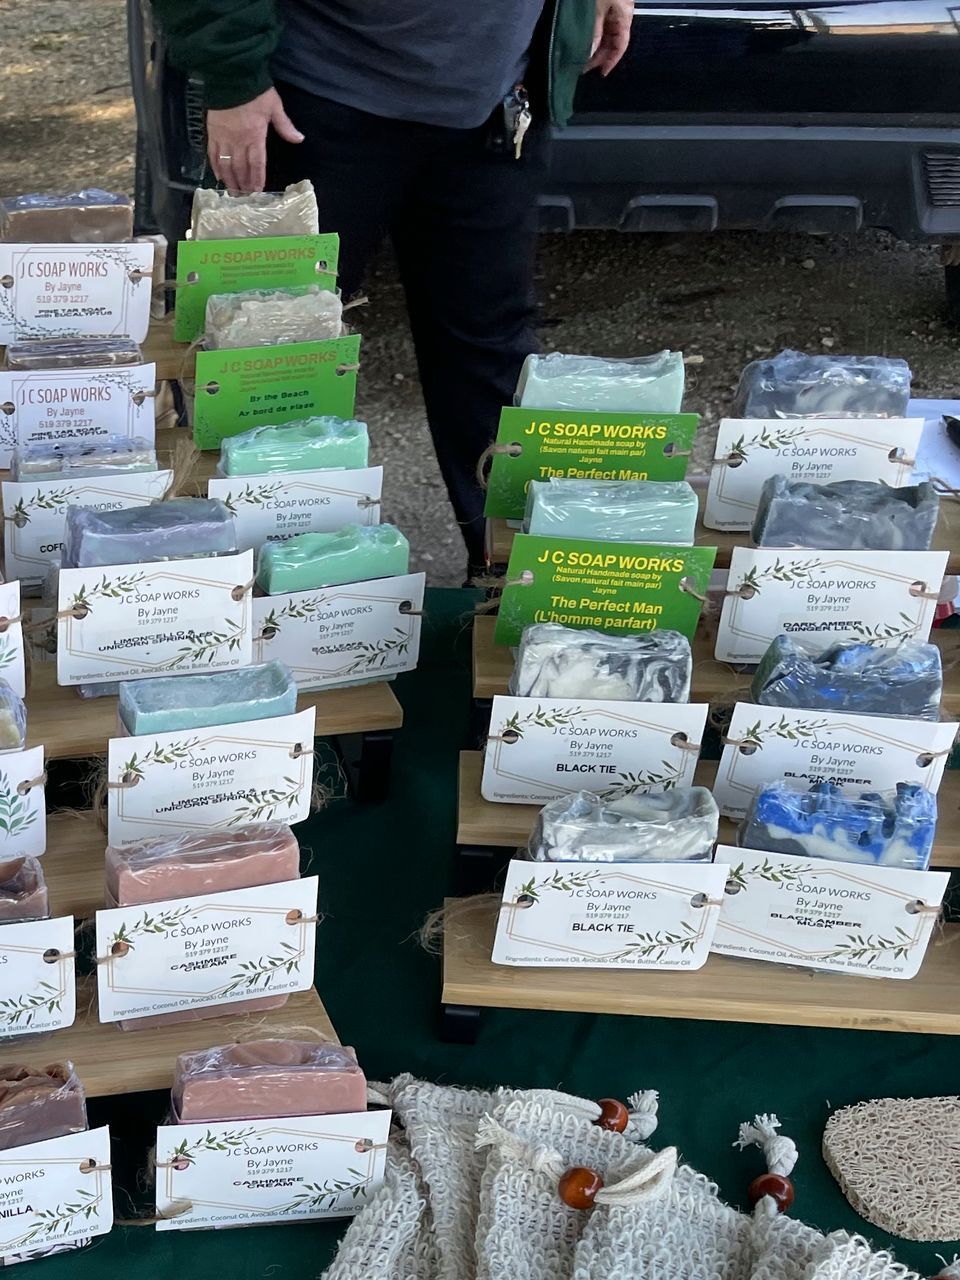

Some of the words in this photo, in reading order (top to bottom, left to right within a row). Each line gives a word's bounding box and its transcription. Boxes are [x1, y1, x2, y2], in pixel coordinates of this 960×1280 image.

[37, 262, 66, 277] SOAP
[69, 261, 108, 277] WORKS
[40, 388, 68, 403] SOAP
[71, 387, 111, 401] WORKS
[554, 424, 602, 437] SOAP
[604, 425, 667, 439] WORKS
[544, 437, 572, 446] Natural
[573, 439, 614, 447] Handmade
[637, 440, 646, 448] by
[540, 446, 568, 454] (Savon
[629, 449, 646, 457] par)
[791, 448, 818, 456] SOAP
[820, 448, 857, 456] WORKS
[579, 456, 603, 464] Jayne
[540, 467, 564, 478] The
[567, 468, 616, 480] Perfect
[619, 470, 648, 481] Man
[568, 552, 616, 568] SOAP
[619, 556, 684, 573] WORKS
[556, 566, 585, 575] Natural
[587, 568, 629, 578] Handmade
[631, 572, 651, 580] soap
[653, 573, 662, 582] by
[552, 574, 580, 584] (Savon
[582, 577, 609, 586] natural
[610, 578, 624, 587] fait
[644, 580, 662, 590] par)
[806, 580, 834, 589] SOAP
[837, 580, 876, 589] WORKS
[592, 586, 617, 595] Jayne
[551, 596, 575, 608] The
[579, 599, 630, 612] Perfect
[633, 602, 663, 614] Man
[534, 610, 602, 626] (L'homme
[192, 772, 205, 782] By
[207, 768, 235, 780] Jayne
[556, 763, 596, 773] BLACK
[599, 764, 616, 774] TIE
[155, 800, 209, 813] UNICORN
[180, 925, 210, 936] SOAP
[212, 917, 252, 931] WORKS
[770, 913, 812, 922] BLACK
[816, 918, 862, 928] AMBER
[572, 923, 612, 932] BLACK
[617, 924, 635, 933] TIE
[185, 940, 198, 951] By
[200, 936, 229, 948] Jayne
[185, 950, 198, 958] 519
[170, 954, 237, 971] CASHMERE
[184, 960, 228, 972] CREAM
[31, 1021, 50, 1029] Castor
[247, 1159, 261, 1168] By
[263, 1157, 293, 1168] Jayne
[4, 1169, 45, 1184] WORKS
[276, 1166, 293, 1174] 1217
[233, 1177, 304, 1186] CASHMERE
